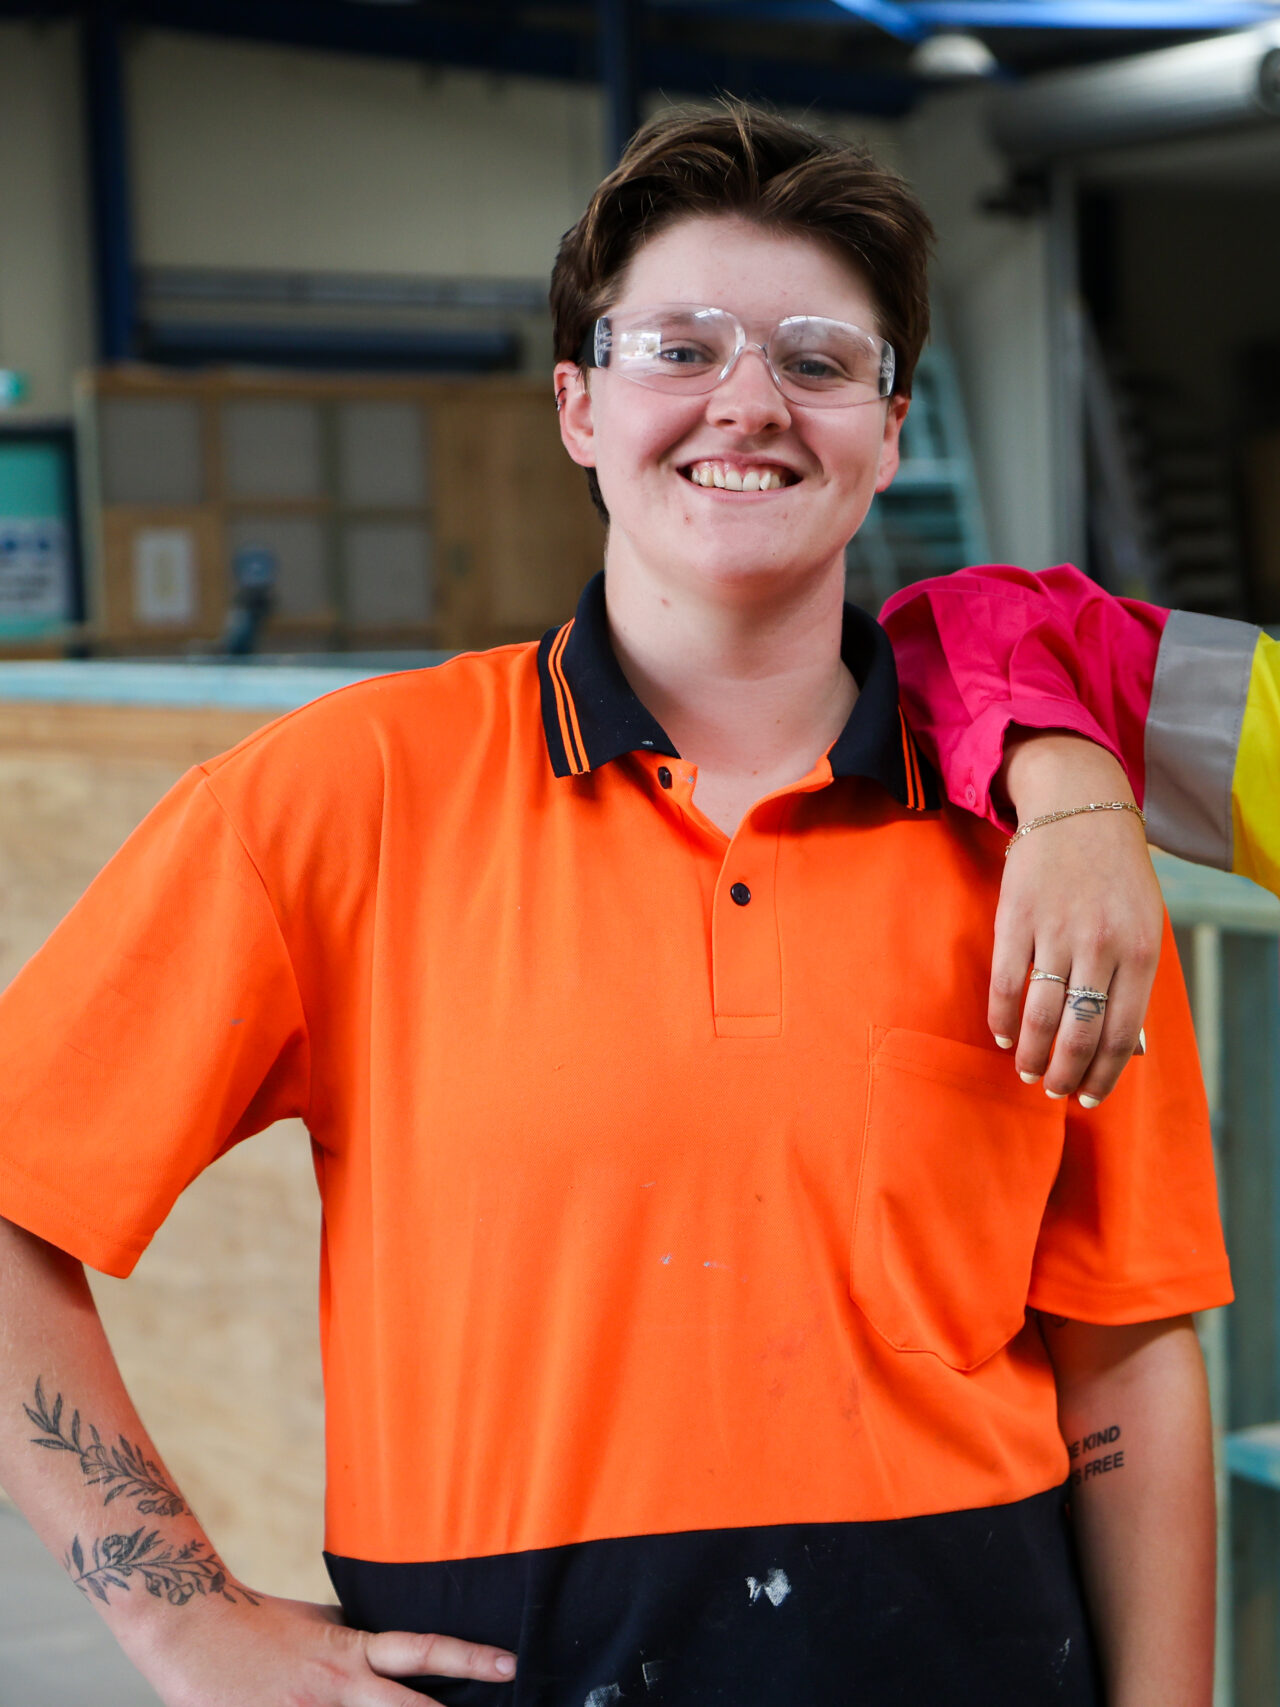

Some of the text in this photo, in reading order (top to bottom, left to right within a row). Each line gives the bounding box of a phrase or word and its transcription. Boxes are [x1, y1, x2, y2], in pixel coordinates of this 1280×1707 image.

[1067, 1425, 1121, 1460] E KIND
[1084, 1451, 1125, 1481] FREE
